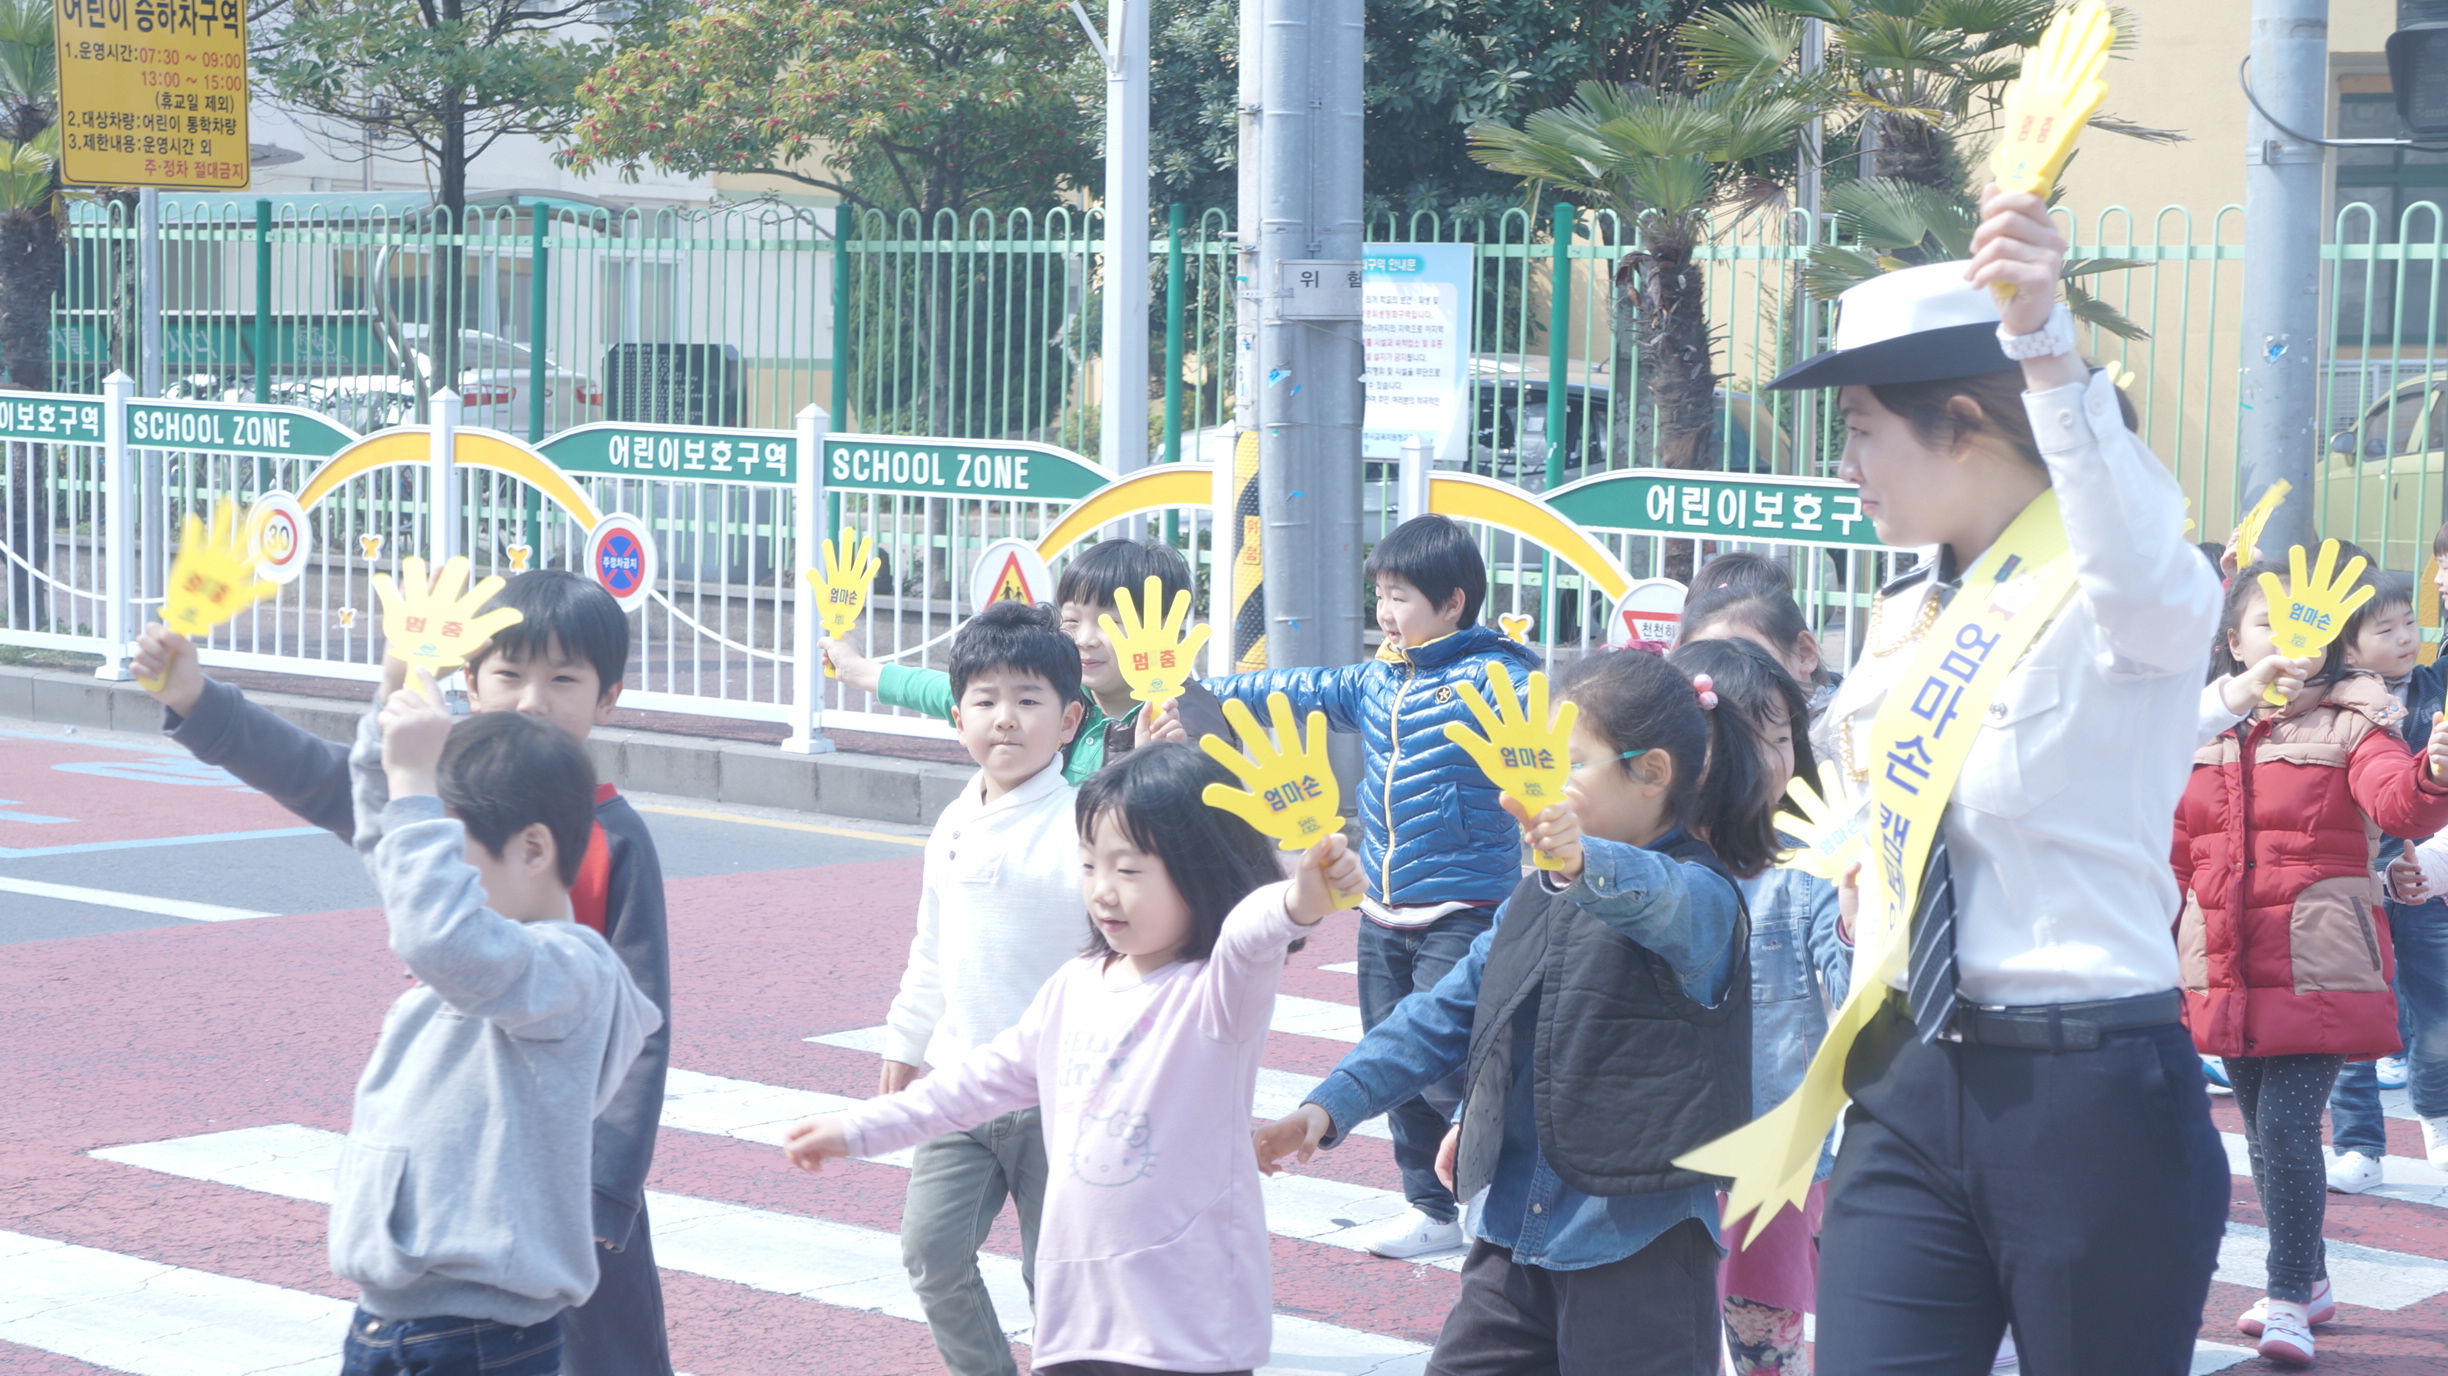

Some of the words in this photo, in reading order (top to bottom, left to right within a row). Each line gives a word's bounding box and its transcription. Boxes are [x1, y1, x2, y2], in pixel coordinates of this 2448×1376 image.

[202, 51, 242, 69] 09:00
[141, 70, 181, 88] 13:00
[204, 74, 242, 92] 15:00
[155, 91, 199, 112] (휴교일
[204, 94, 235, 115] 제외)
[186, 116, 237, 136] 통학차량
[200, 139, 213, 157] 외
[194, 160, 244, 181] 절대금지
[1388, 258, 1417, 271] 안내문
[134, 410, 225, 445] SCHOOL
[233, 415, 291, 449] ZONE
[608, 434, 788, 477] 어린이보호구역
[832, 447, 945, 486] SCHOOL
[956, 453, 1029, 490] ZONE
[1646, 484, 1866, 536] 어린이보호구
[266, 524, 290, 549] 30
[602, 556, 637, 570] 주정차금지
[829, 587, 858, 605] 엄마손
[2289, 602, 2332, 631] 엄마손
[1642, 622, 1675, 639] 천천히
[1500, 747, 1556, 769] 엄마손
[1263, 774, 1323, 812] 엄마손
